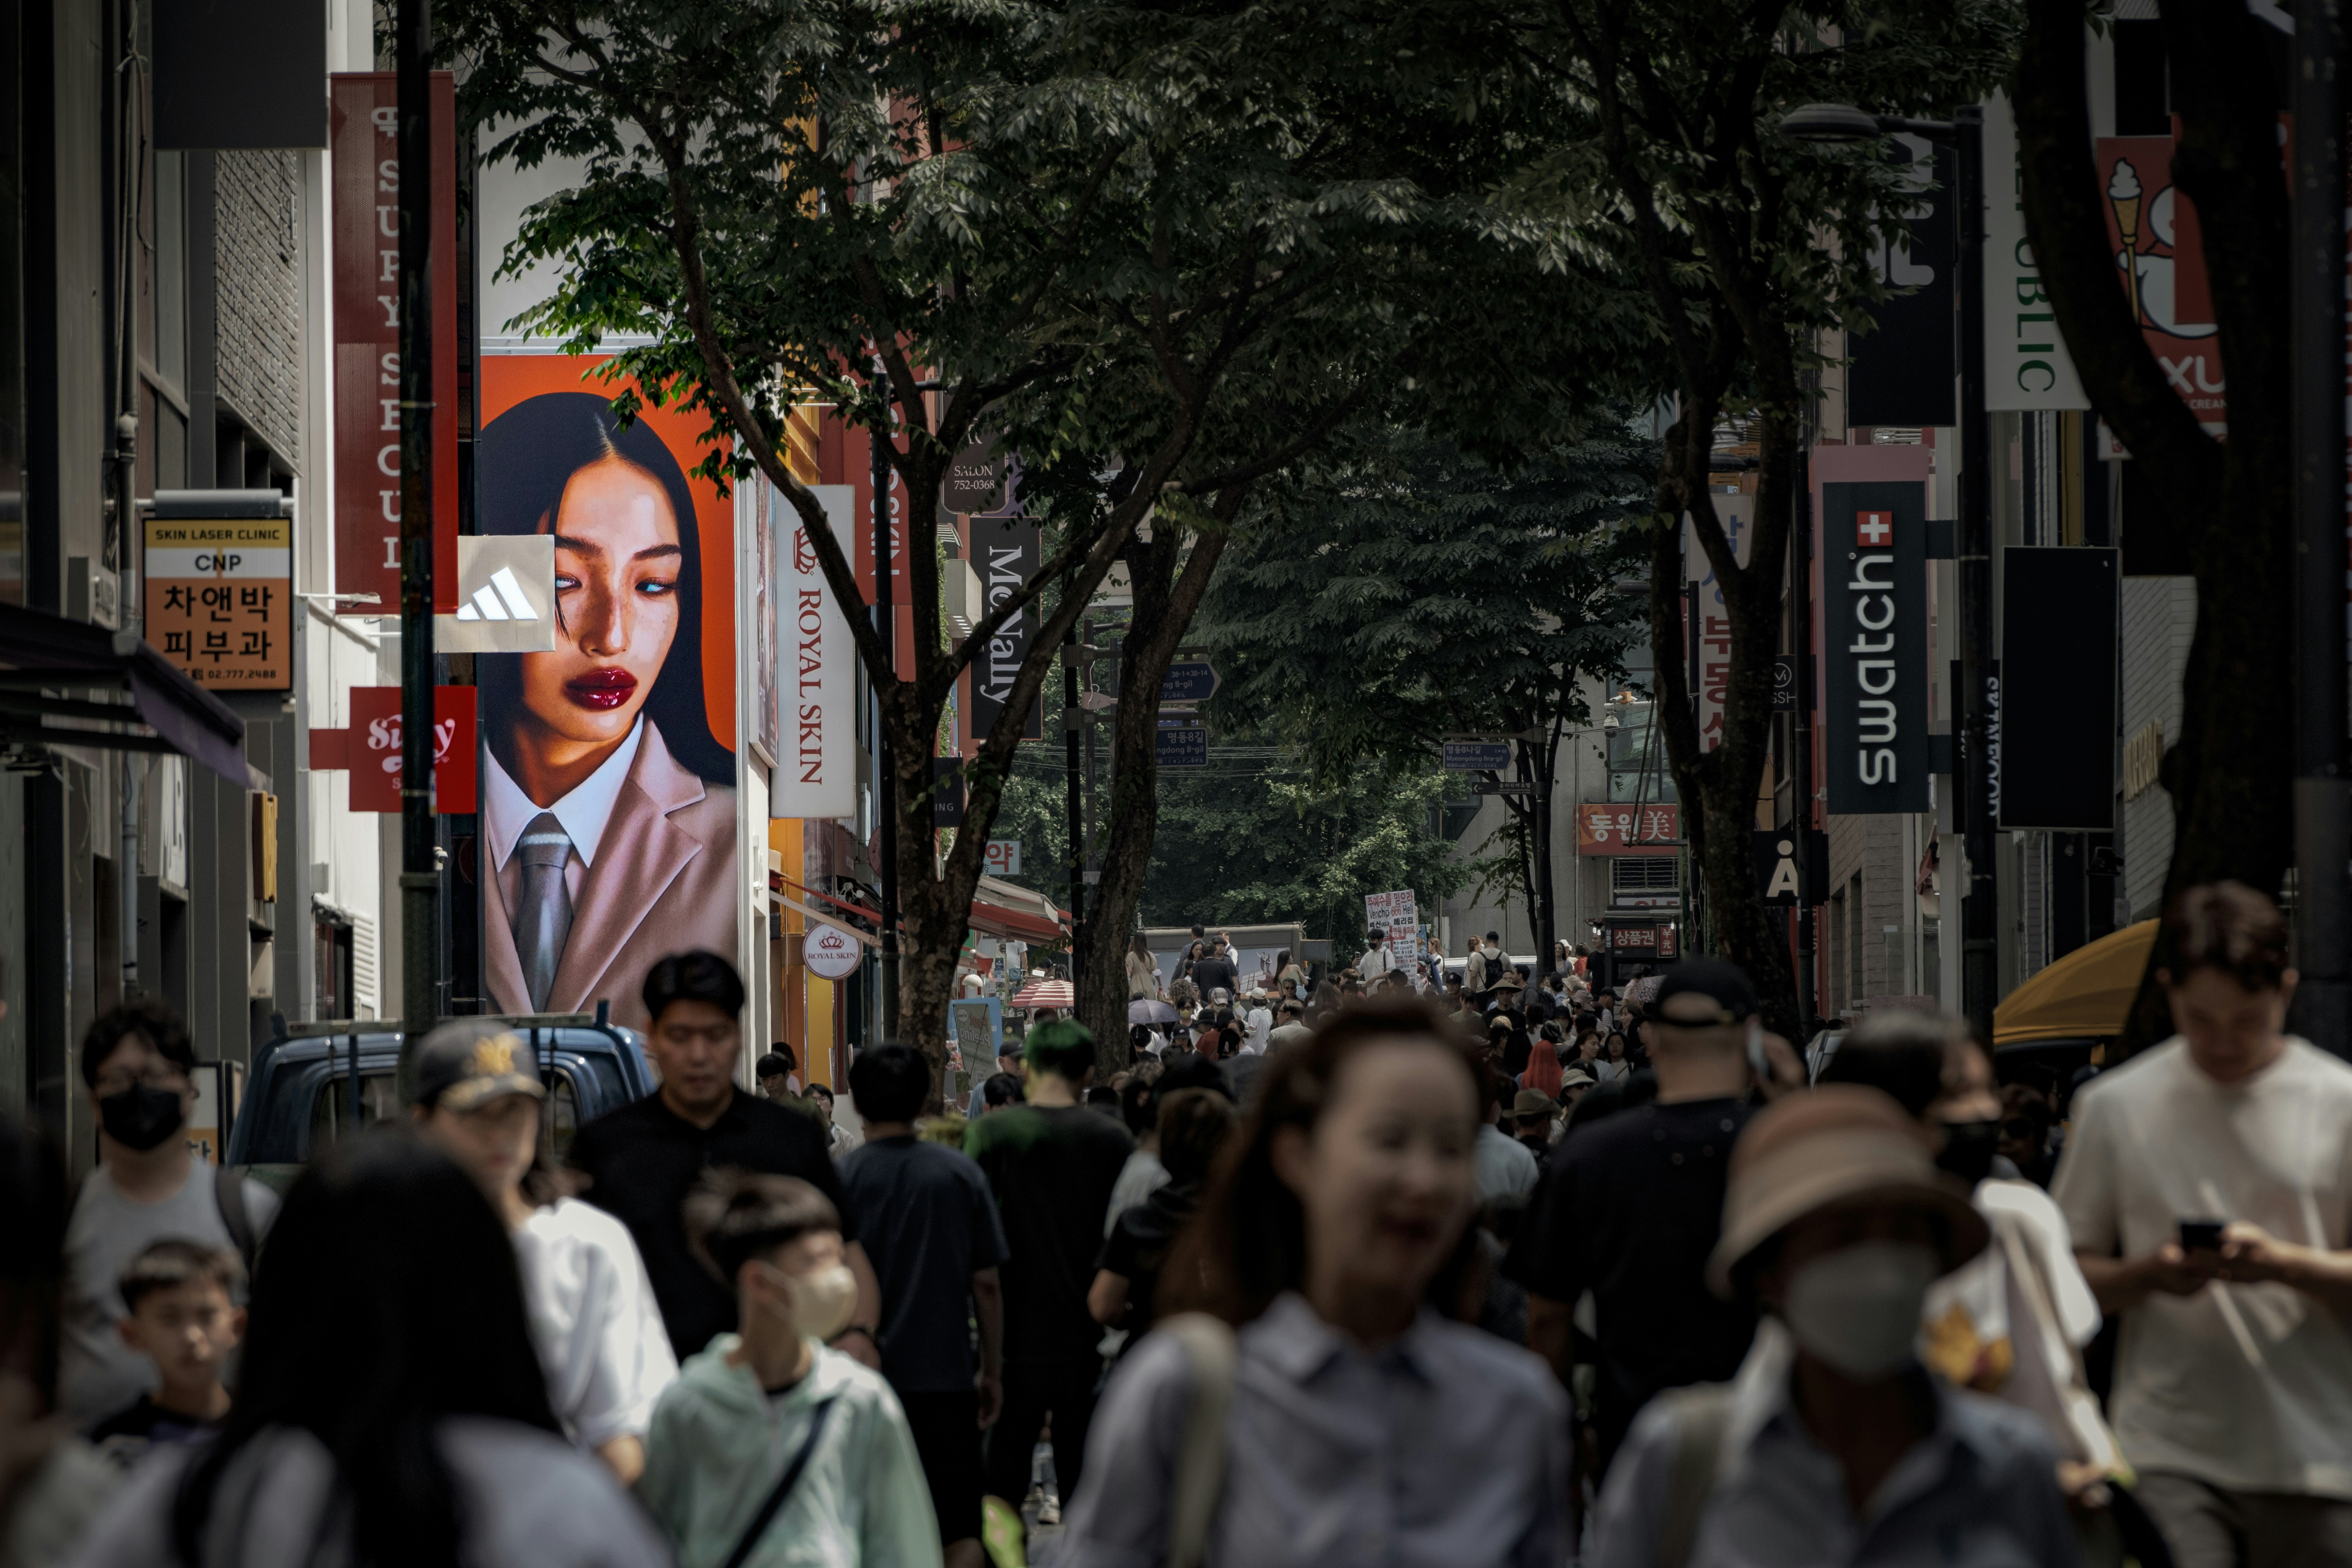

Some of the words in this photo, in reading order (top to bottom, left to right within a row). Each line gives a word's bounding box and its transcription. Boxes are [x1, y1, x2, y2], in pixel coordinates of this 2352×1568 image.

[954, 465, 993, 476] SALON
[954, 480, 995, 490] 752-0368
[156, 530, 187, 540] SKIN
[191, 530, 233, 540] LASER
[238, 530, 280, 540] CLINIC
[195, 555, 241, 571] CNP
[164, 585, 274, 623] 차앤박
[164, 630, 273, 662] 피부과
[799, 588, 822, 698] ROYAL
[1848, 555, 1897, 785] swatch
[1175, 680, 1193, 689] 8-gil
[799, 705, 822, 785] SKIN
[1167, 731, 1204, 744] 명동8길
[1156, 746, 1185, 755] ngdong
[1187, 746, 1204, 754] 8-gil
[1446, 746, 1481, 754] 명동8나길
[935, 803, 954, 812] ING
[985, 843, 1014, 873] 약
[1367, 893, 1392, 909] 주예수를
[1393, 890, 1413, 905] 믿으라
[1369, 907, 1390, 919] Verichip
[1391, 905, 1401, 917] 666
[1403, 904, 1413, 915] Hell
[1615, 930, 1654, 945] 상품권
